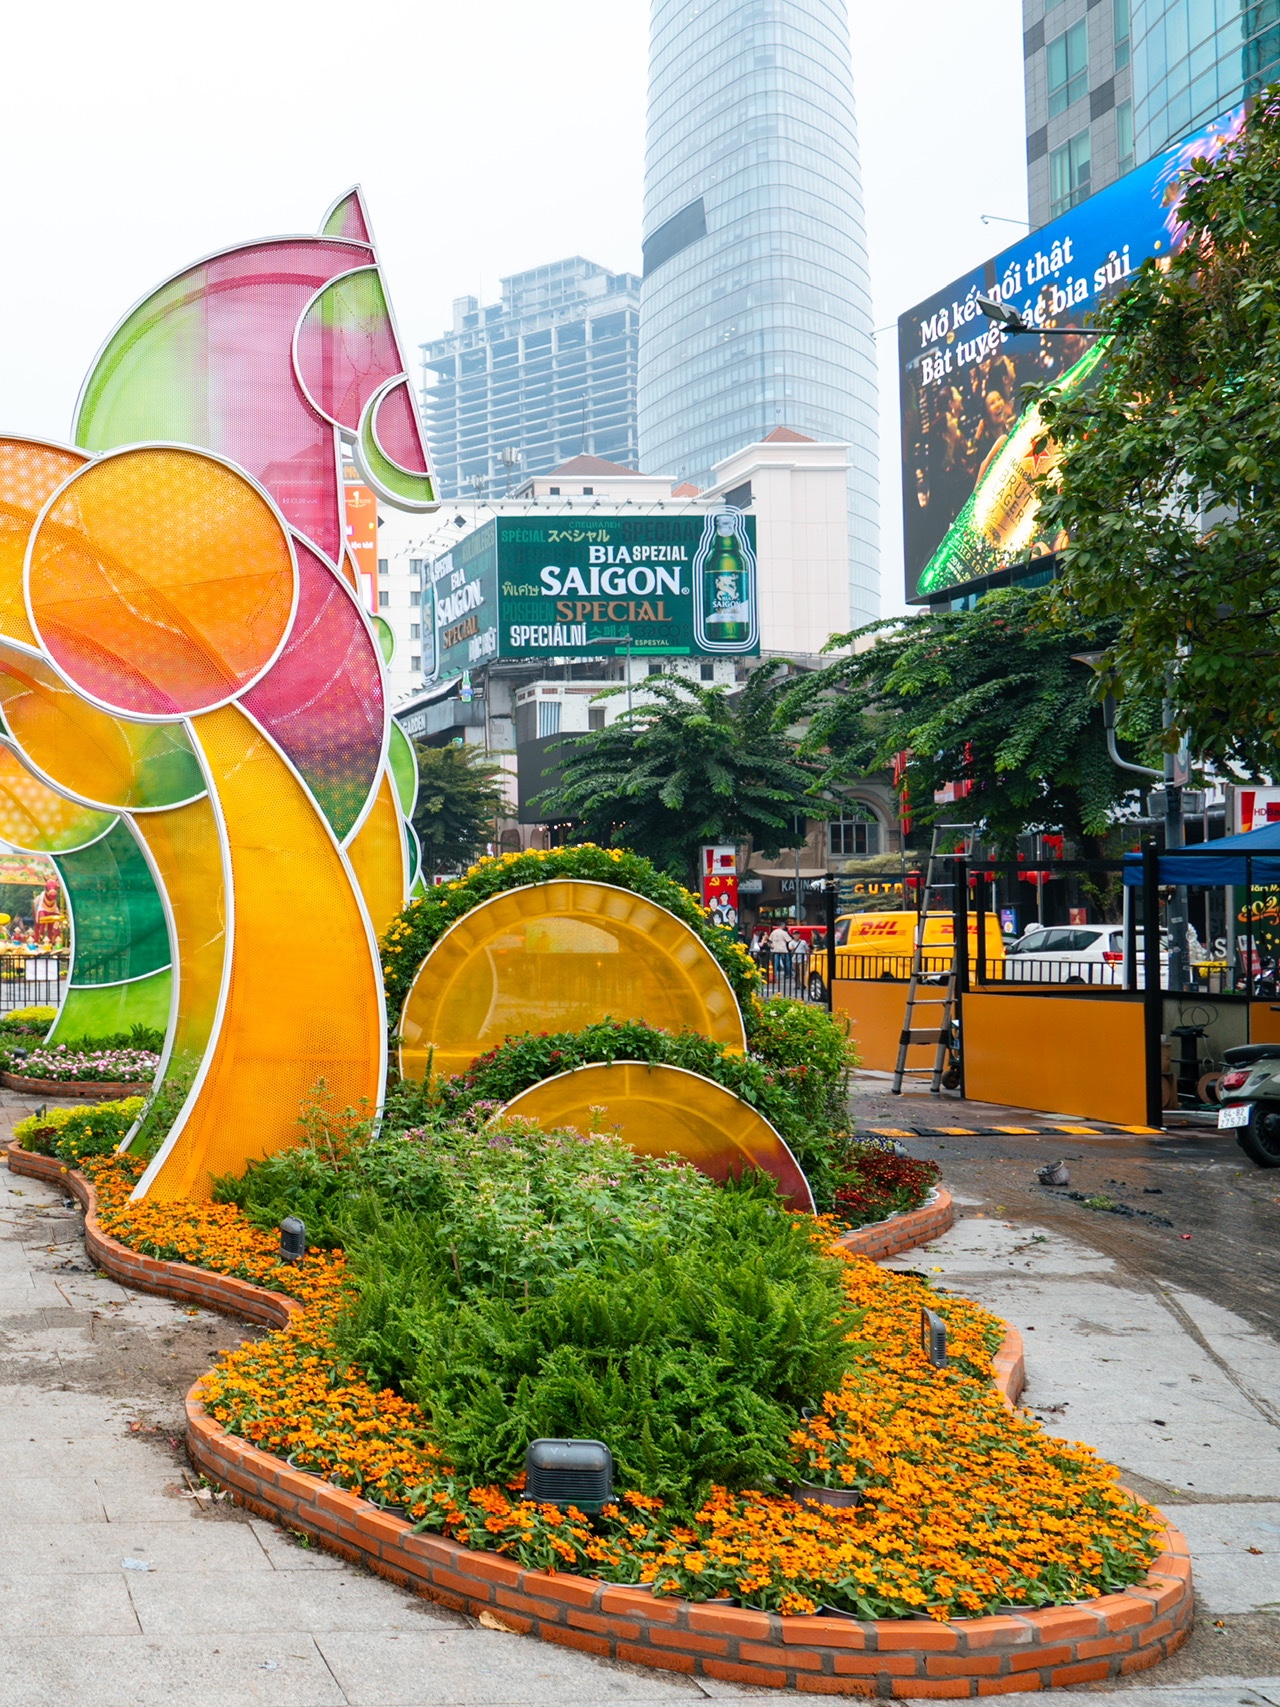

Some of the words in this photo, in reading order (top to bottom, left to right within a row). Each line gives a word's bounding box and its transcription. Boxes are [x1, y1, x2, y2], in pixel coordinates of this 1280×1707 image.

[920, 308, 949, 348] Mở
[951, 284, 983, 330] kết
[987, 261, 1022, 304] nối
[1025, 236, 1074, 286] thật
[921, 348, 953, 387] Bật
[955, 319, 1009, 364] tuyệt
[1050, 276, 1089, 316] bia
[1093, 244, 1132, 294] sủi
[999, 469, 1038, 509] BRUT
[501, 528, 547, 544] SPÉCIAL
[569, 521, 621, 530] СПЕЦИАЛЕН
[548, 529, 611, 544] スペシャル
[588, 545, 634, 564] BIA
[632, 545, 689, 561] SPEZIAL
[450, 568, 466, 591] BIA
[501, 580, 540, 597] พิเศษ
[539, 565, 683, 597] SAIGON
[437, 579, 483, 628] SAIGON
[502, 601, 555, 622] POSEBEN
[556, 601, 674, 622] SPECIAL
[510, 622, 588, 648] SPECIÁLNÍ
[859, 921, 898, 936] DHL
